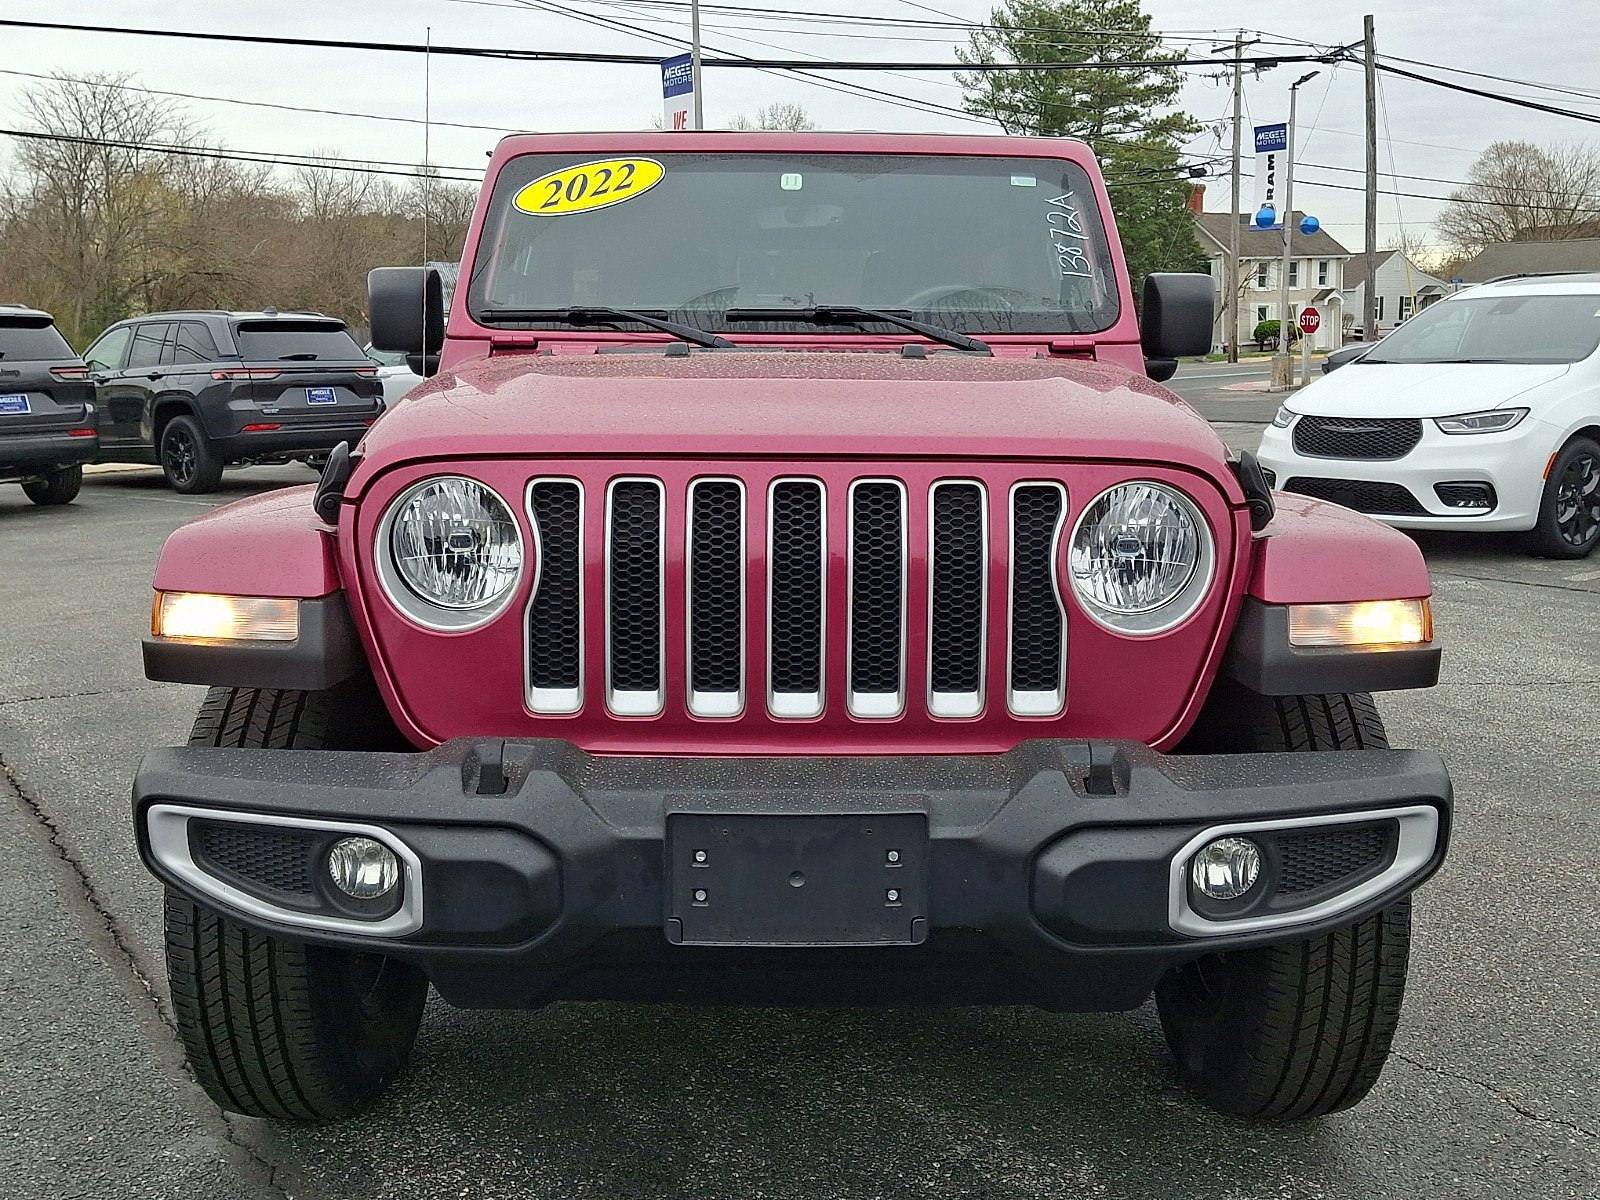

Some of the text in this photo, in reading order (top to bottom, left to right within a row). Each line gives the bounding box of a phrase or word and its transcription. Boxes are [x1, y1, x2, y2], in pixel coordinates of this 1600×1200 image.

[664, 63, 691, 80] MEGEE
[664, 75, 692, 88] MOTORS
[673, 110, 688, 130] WE
[1256, 129, 1286, 141] MEGEE
[1256, 139, 1286, 147] MOTORS
[1266, 154, 1275, 201] RAM
[539, 163, 636, 210] 2022
[1300, 315, 1320, 326] STOP
